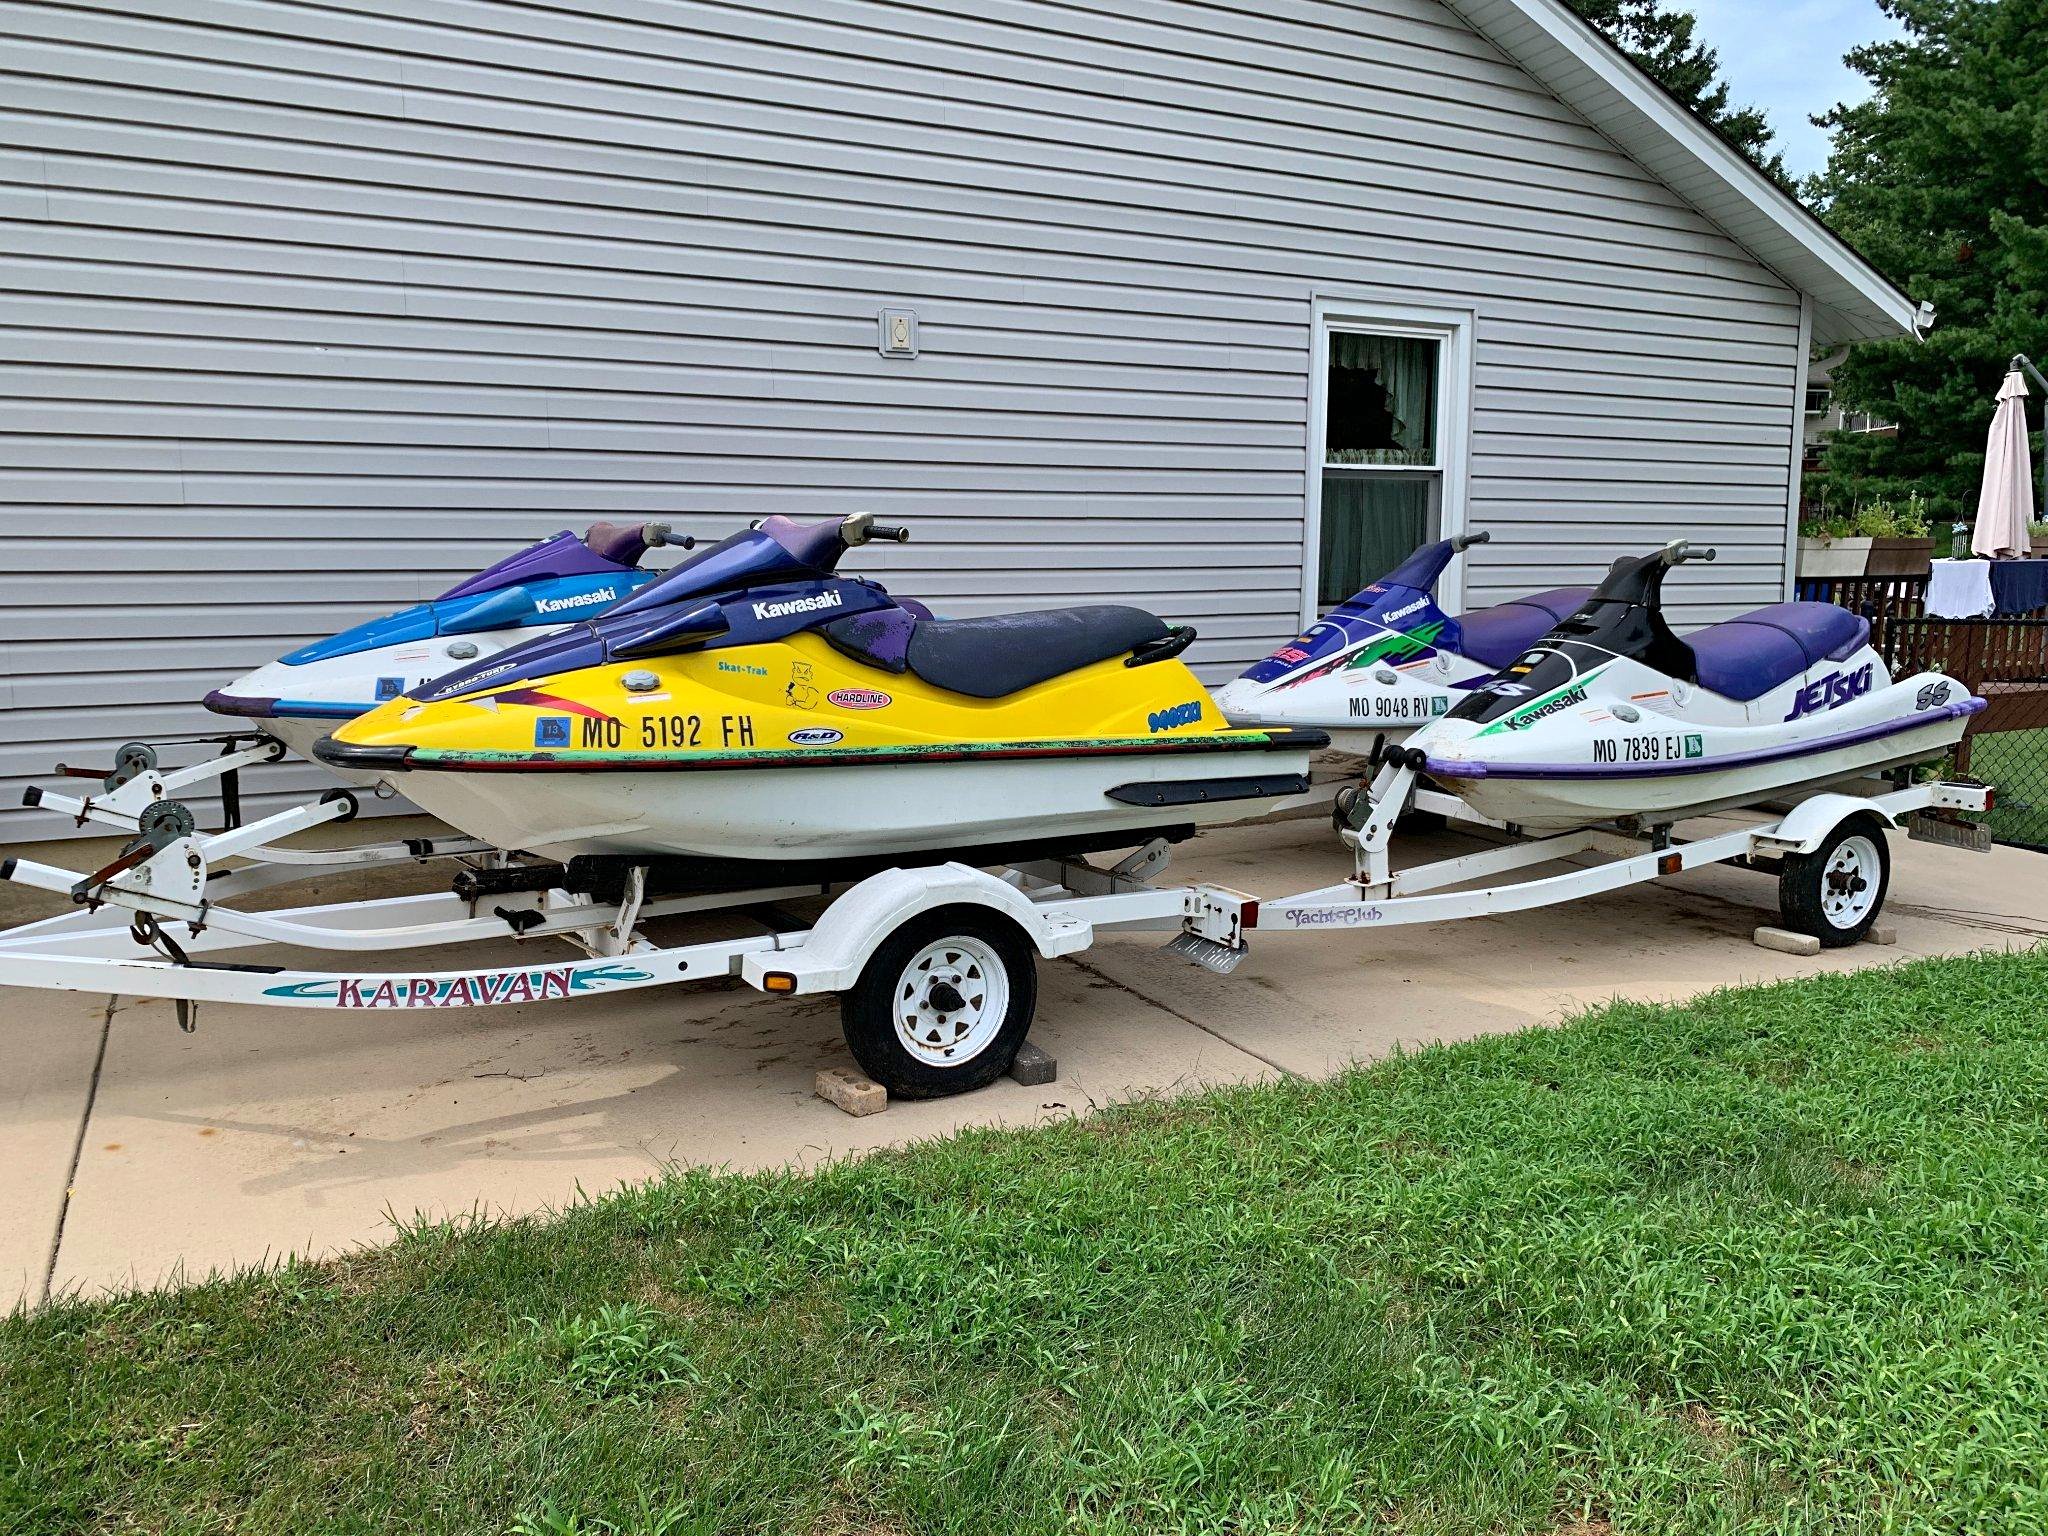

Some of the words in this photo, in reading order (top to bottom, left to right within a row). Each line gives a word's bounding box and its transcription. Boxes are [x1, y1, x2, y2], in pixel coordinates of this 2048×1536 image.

[535, 586, 617, 615] Kawasaki
[751, 589, 843, 621] Kawasaki
[1381, 595, 1431, 624] Kawasaki
[718, 661, 768, 677] Skat-Trak
[836, 692, 884, 704] HARDLINE
[1348, 697, 1370, 718] MO
[1375, 697, 1408, 718] 9048
[1413, 696, 1429, 717] RV
[1504, 684, 1588, 731] Kawasaki
[1916, 680, 1952, 711] SS
[546, 724, 560, 735] 13
[582, 716, 622, 748] MO
[642, 714, 702, 747] 5192
[721, 715, 755, 747] FH
[794, 731, 838, 742] R&D
[1592, 738, 1617, 763] MO
[1623, 736, 1660, 761] 7839
[1666, 736, 1681, 759] EJ
[1285, 906, 1334, 928] Yacht
[1336, 905, 1383, 925] Club
[335, 967, 575, 1009] KARAVAN
